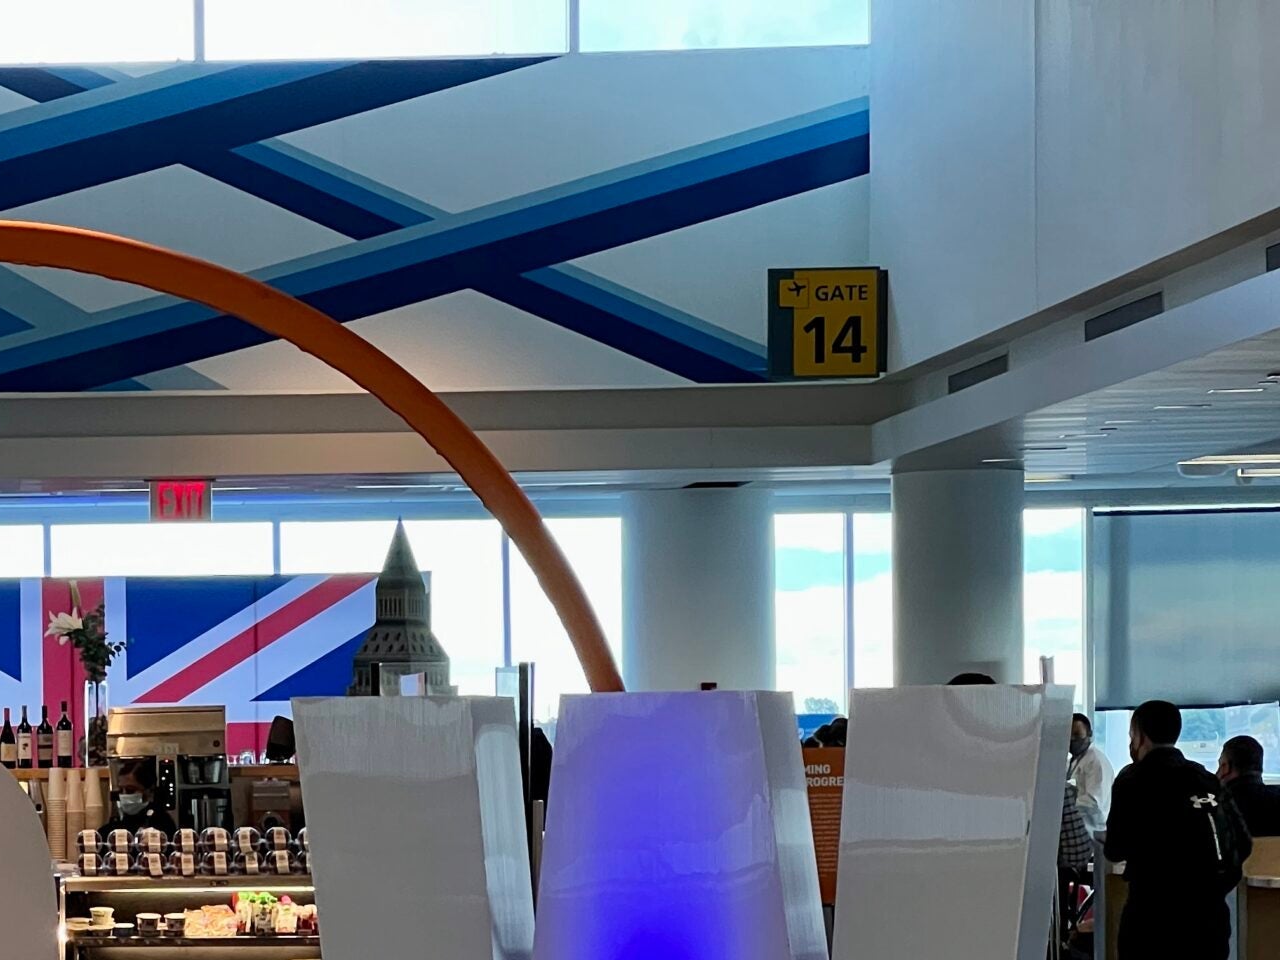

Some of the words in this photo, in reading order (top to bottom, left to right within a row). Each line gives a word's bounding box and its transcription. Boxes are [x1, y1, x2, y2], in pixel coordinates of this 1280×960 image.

[815, 284, 868, 302] GATE
[803, 315, 867, 364] 14
[158, 481, 206, 519] EXIT
[805, 764, 831, 774] MING
[806, 776, 844, 787] ROGRE
